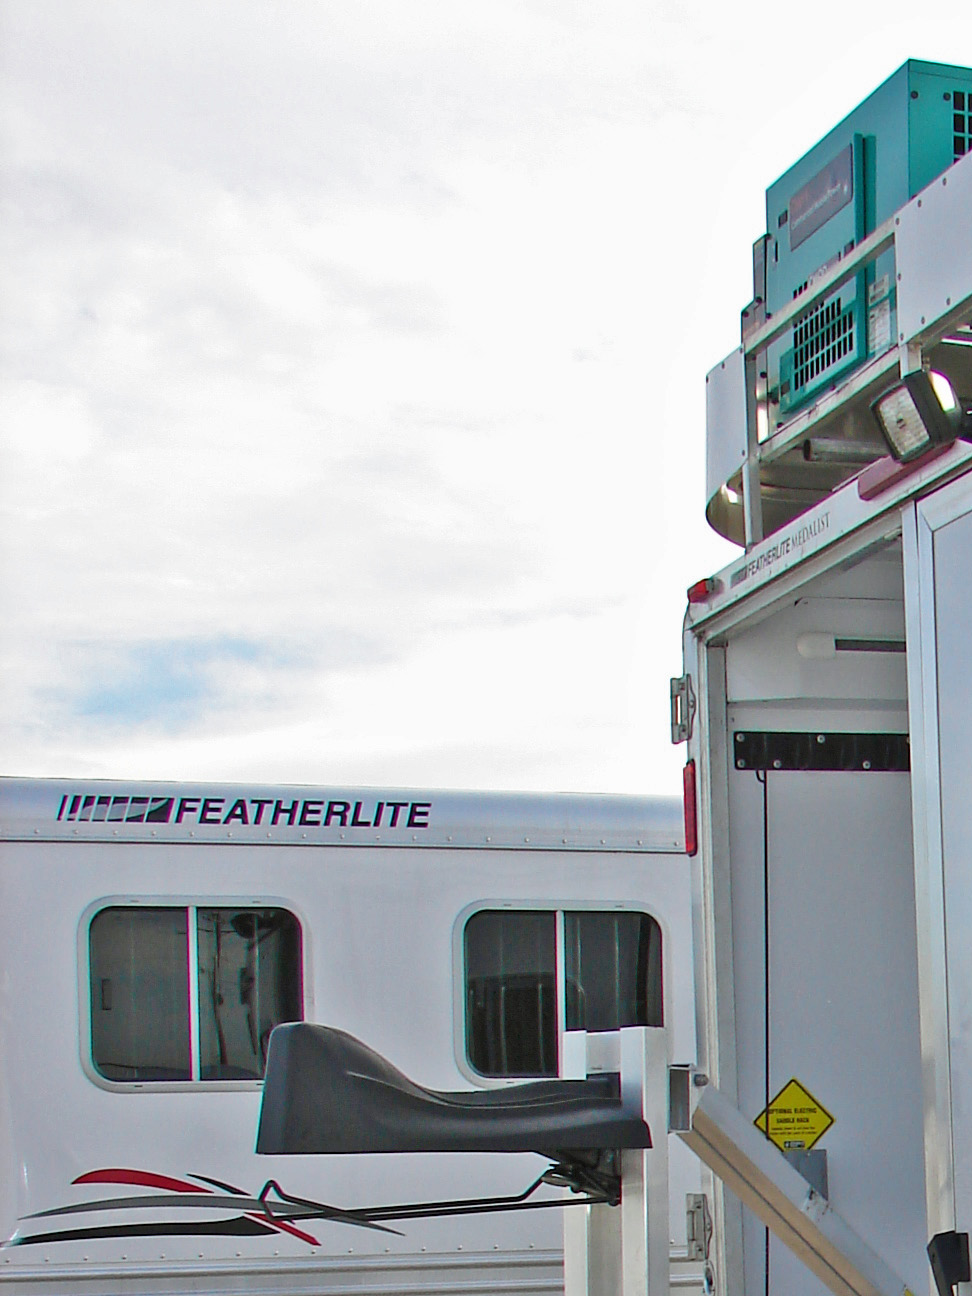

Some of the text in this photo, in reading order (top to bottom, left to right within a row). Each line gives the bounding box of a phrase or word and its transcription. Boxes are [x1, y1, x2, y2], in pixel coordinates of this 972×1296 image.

[748, 511, 830, 577] FEATHERLITE MEDALIST
[174, 797, 432, 829] FEATHERLITE
